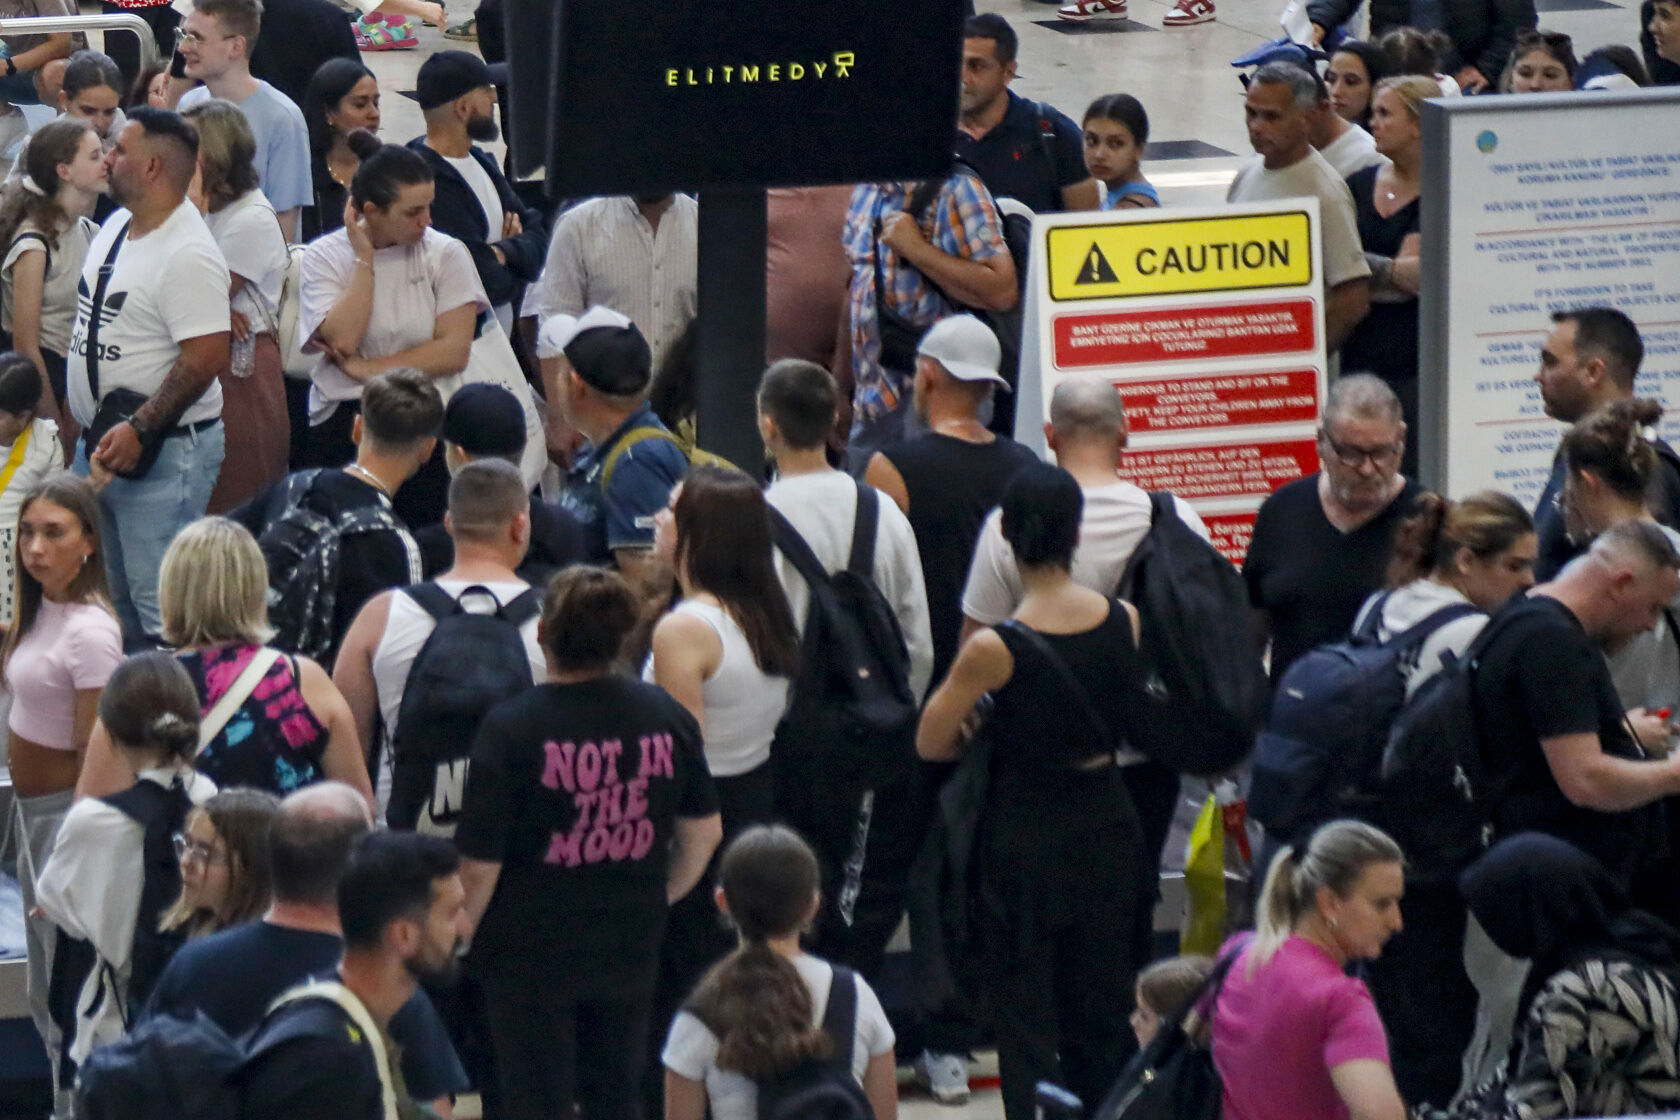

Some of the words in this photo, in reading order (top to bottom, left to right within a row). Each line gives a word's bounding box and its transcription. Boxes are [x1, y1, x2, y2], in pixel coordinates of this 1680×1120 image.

[1135, 239, 1290, 276] CAUTION
[541, 739, 623, 793] NOT
[637, 732, 674, 779] IN
[574, 776, 650, 831] THE
[543, 818, 655, 868] MOOD
